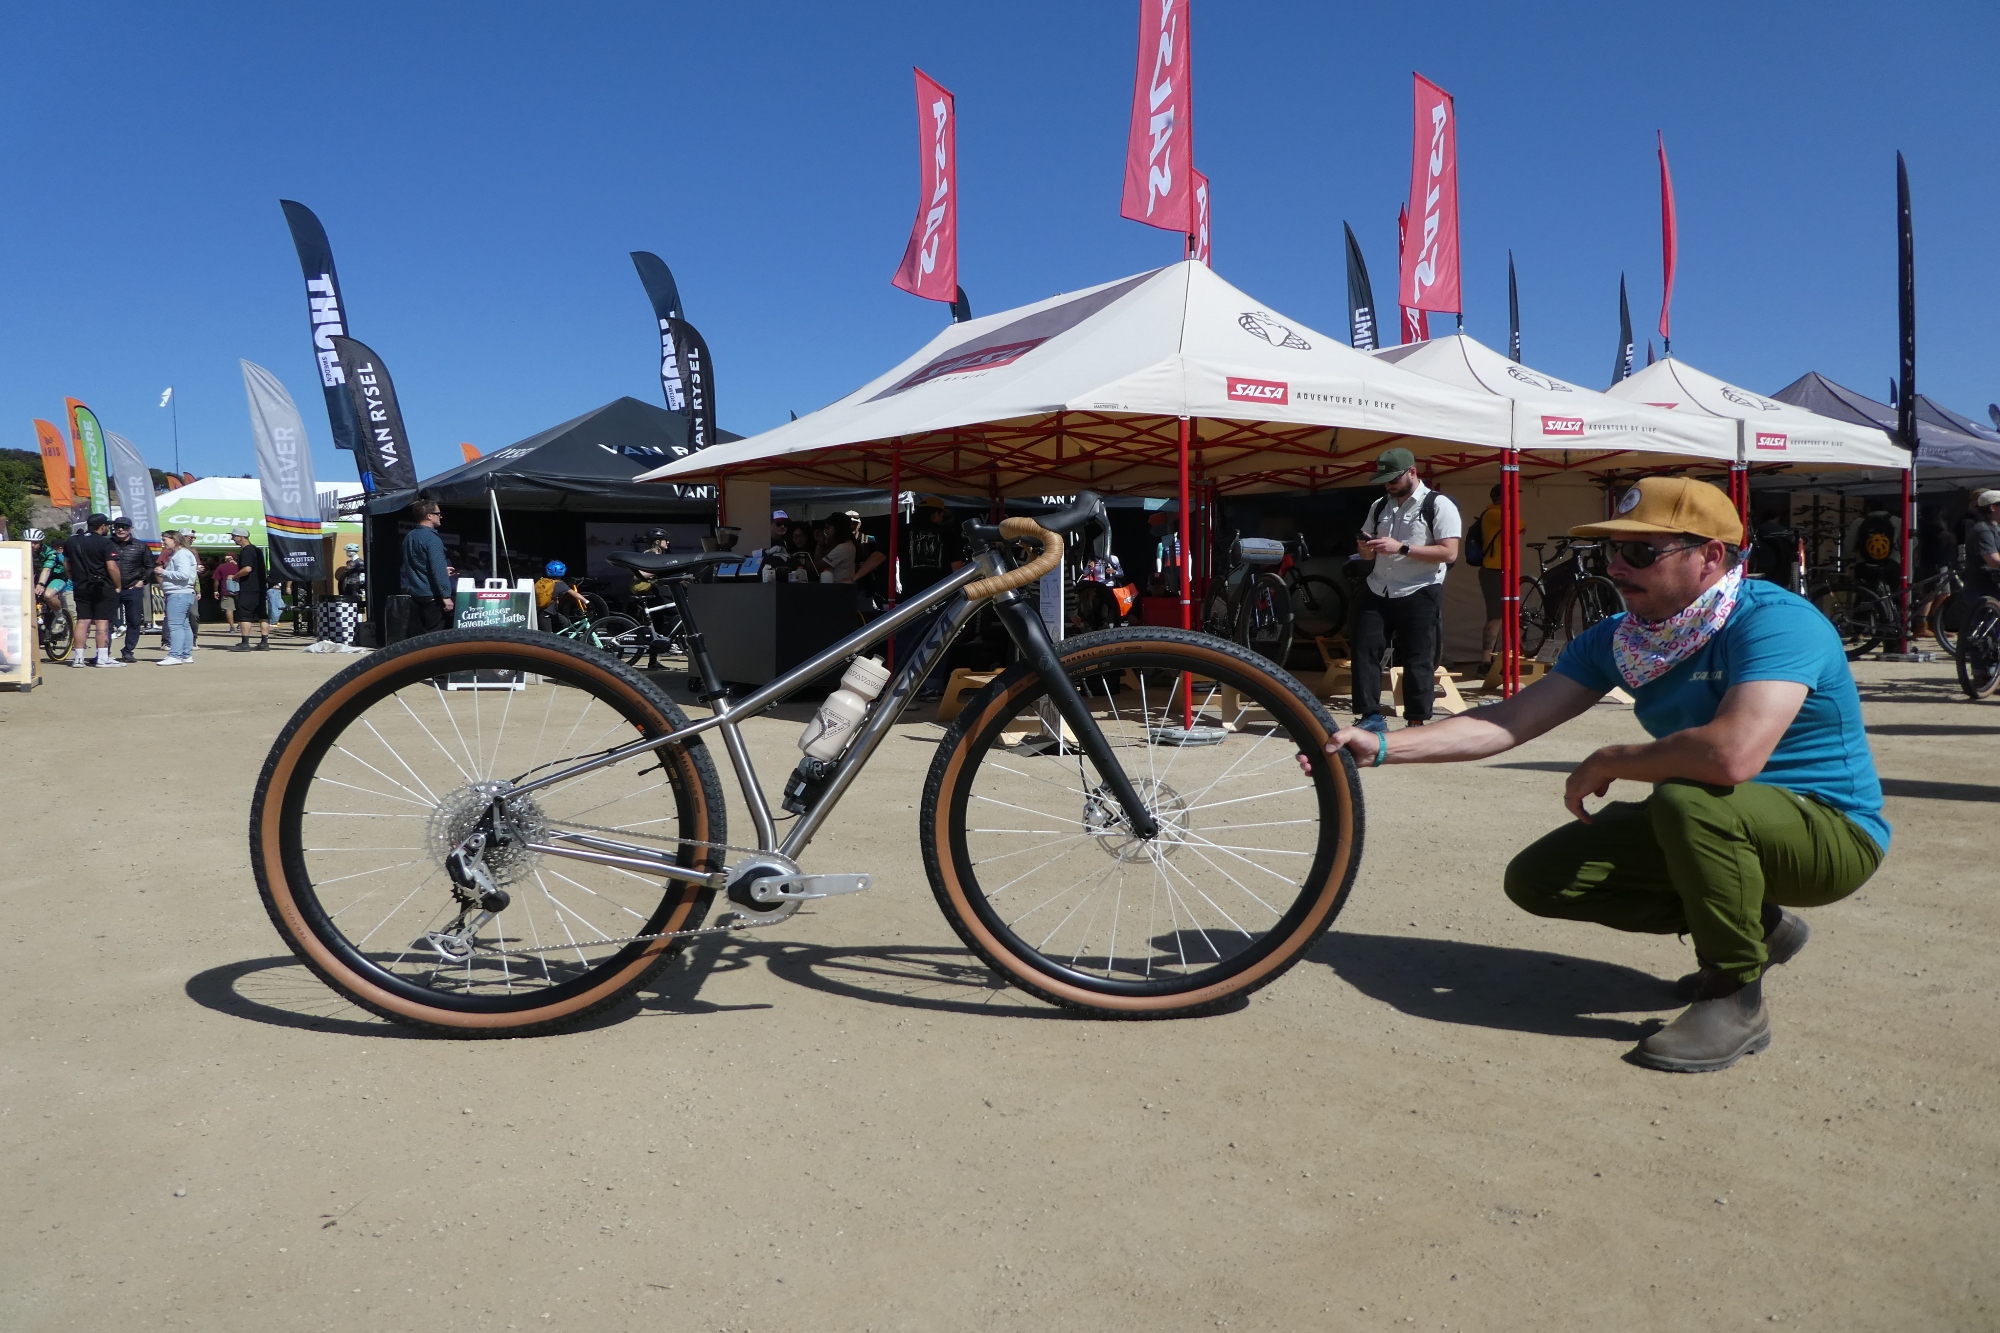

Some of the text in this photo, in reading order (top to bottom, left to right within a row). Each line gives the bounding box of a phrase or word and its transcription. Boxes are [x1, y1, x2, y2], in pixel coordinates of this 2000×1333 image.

[917, 97, 947, 290] SALSA
[1414, 100, 1447, 304] SALSA
[321, 356, 333, 383] SWEDEN
[687, 347, 704, 410] RYSEL
[1230, 383, 1396, 410] SALSA ADVENTURE BY BIKE
[357, 362, 399, 468] VAN RYSEL
[1545, 420, 1583, 431] SALSA
[1588, 423, 1628, 432] ADVENTURE
[82, 419, 99, 468] CORE
[597, 443, 666, 457] VAN
[1757, 436, 1786, 447] SALSA
[274, 426, 302, 505] SILVER
[129, 476, 149, 531] SILVER
[672, 484, 708, 500] VAN
[1041, 495, 1065, 505] VAN
[168, 514, 255, 527] CUSH
[193, 532, 234, 544] COR
[461, 606, 511, 620] Curiouser
[502, 612, 526, 624] Latte
[892, 612, 957, 711] SALSA
